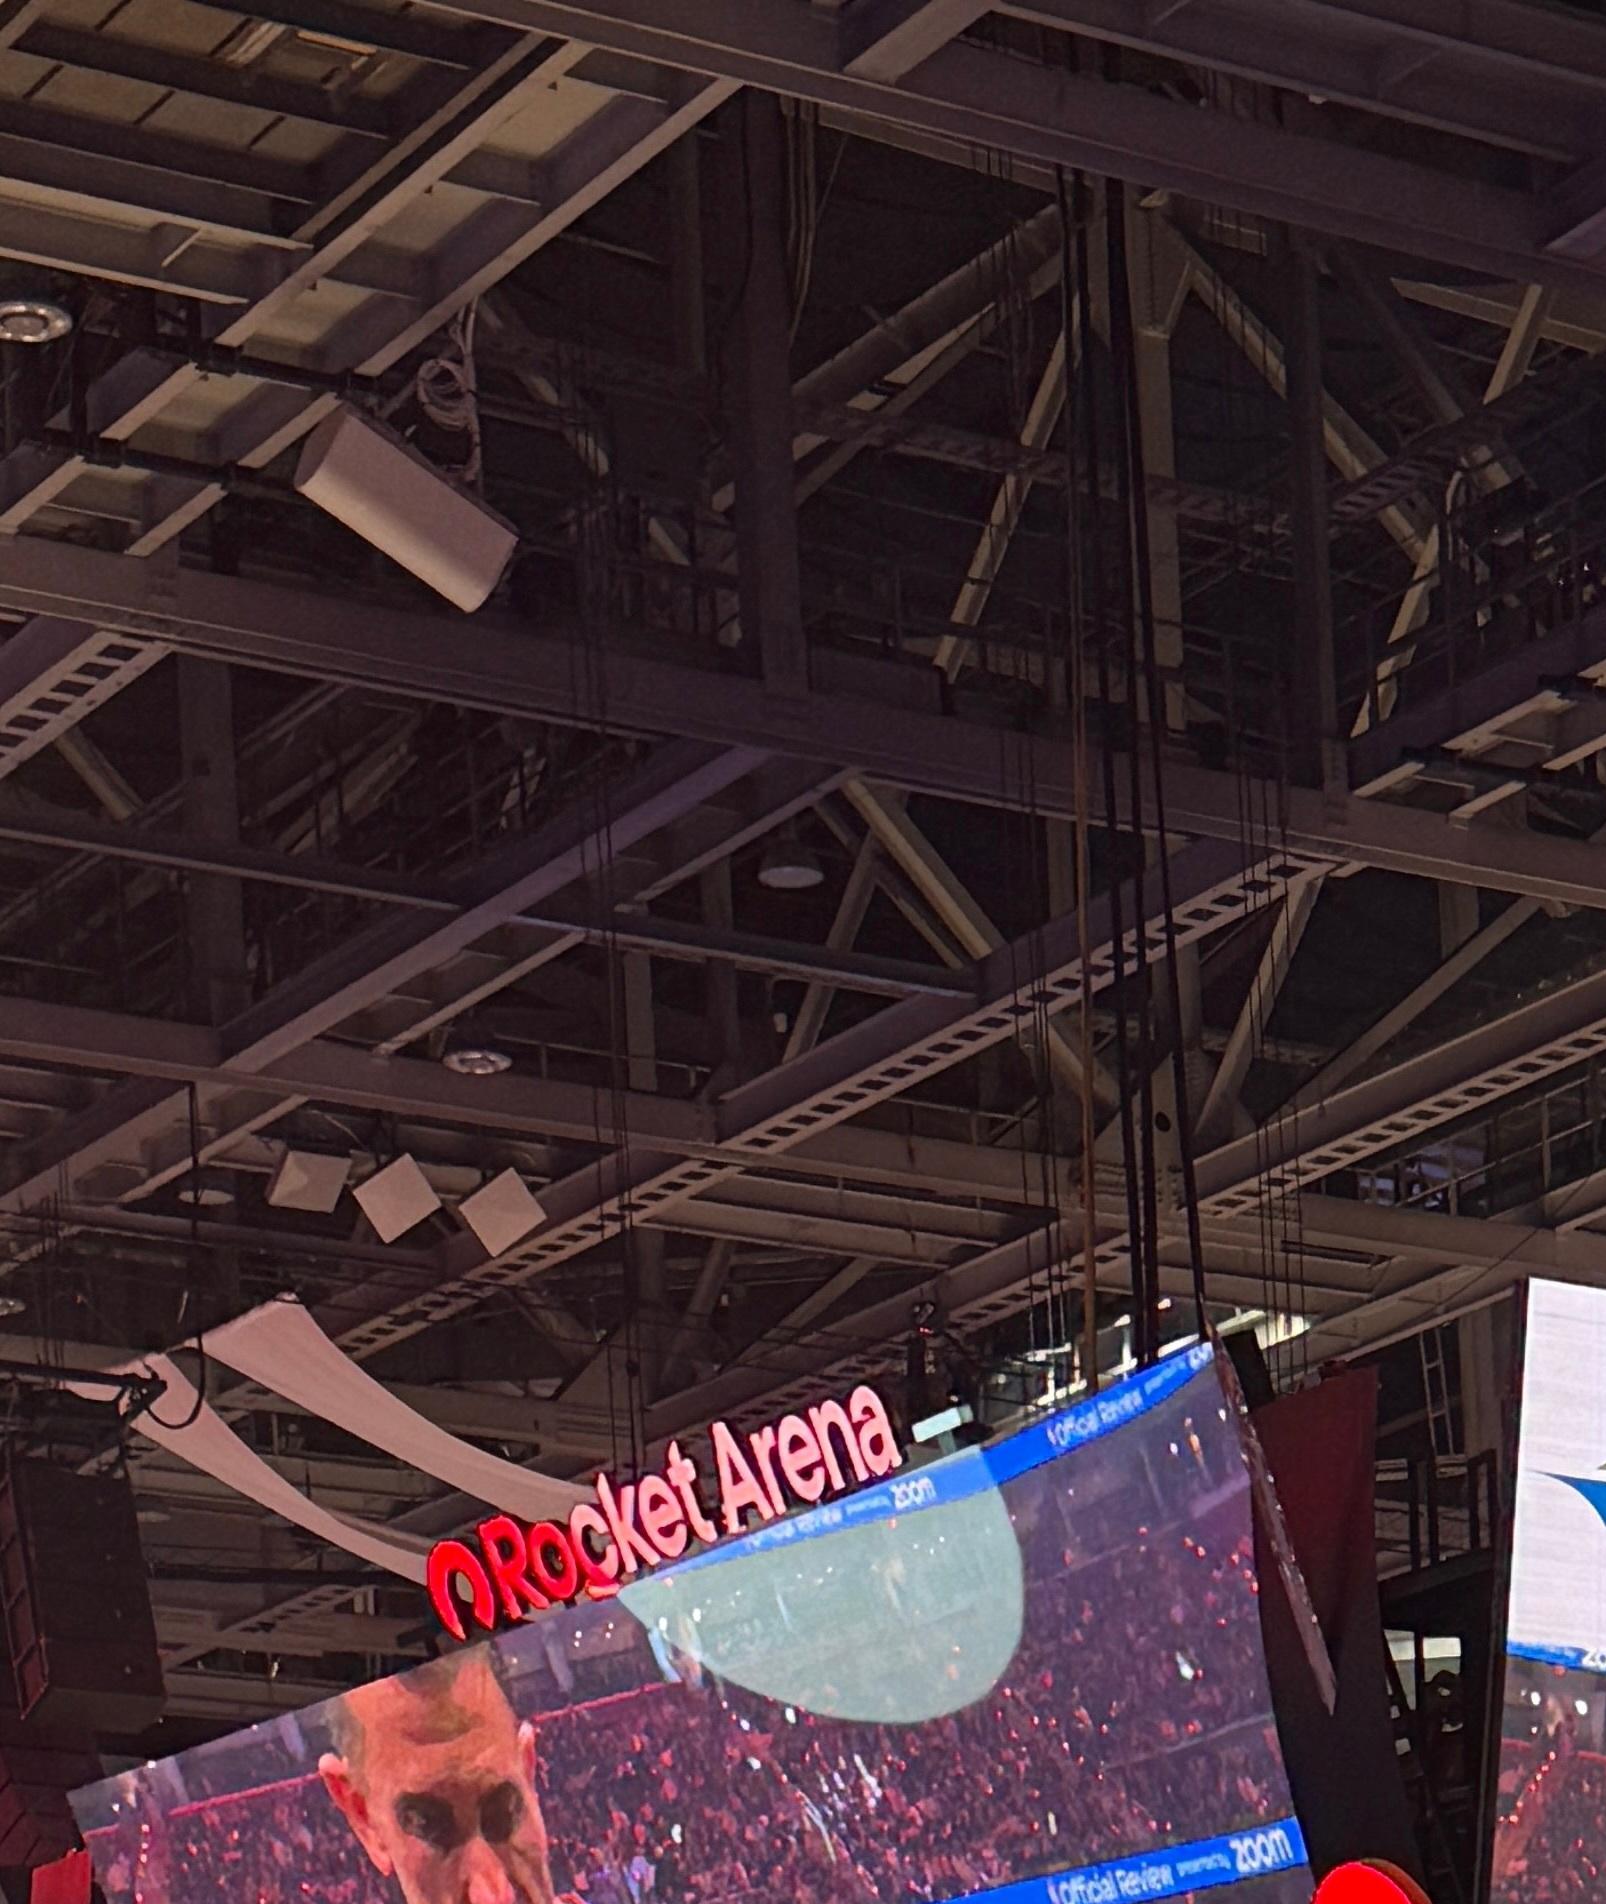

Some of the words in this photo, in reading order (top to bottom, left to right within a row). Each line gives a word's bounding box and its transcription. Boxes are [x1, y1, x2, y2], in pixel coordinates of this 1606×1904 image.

[475, 1438, 718, 1622] Rocket
[711, 1383, 903, 1536] Arena
[1229, 1828, 1294, 1874] zoom
